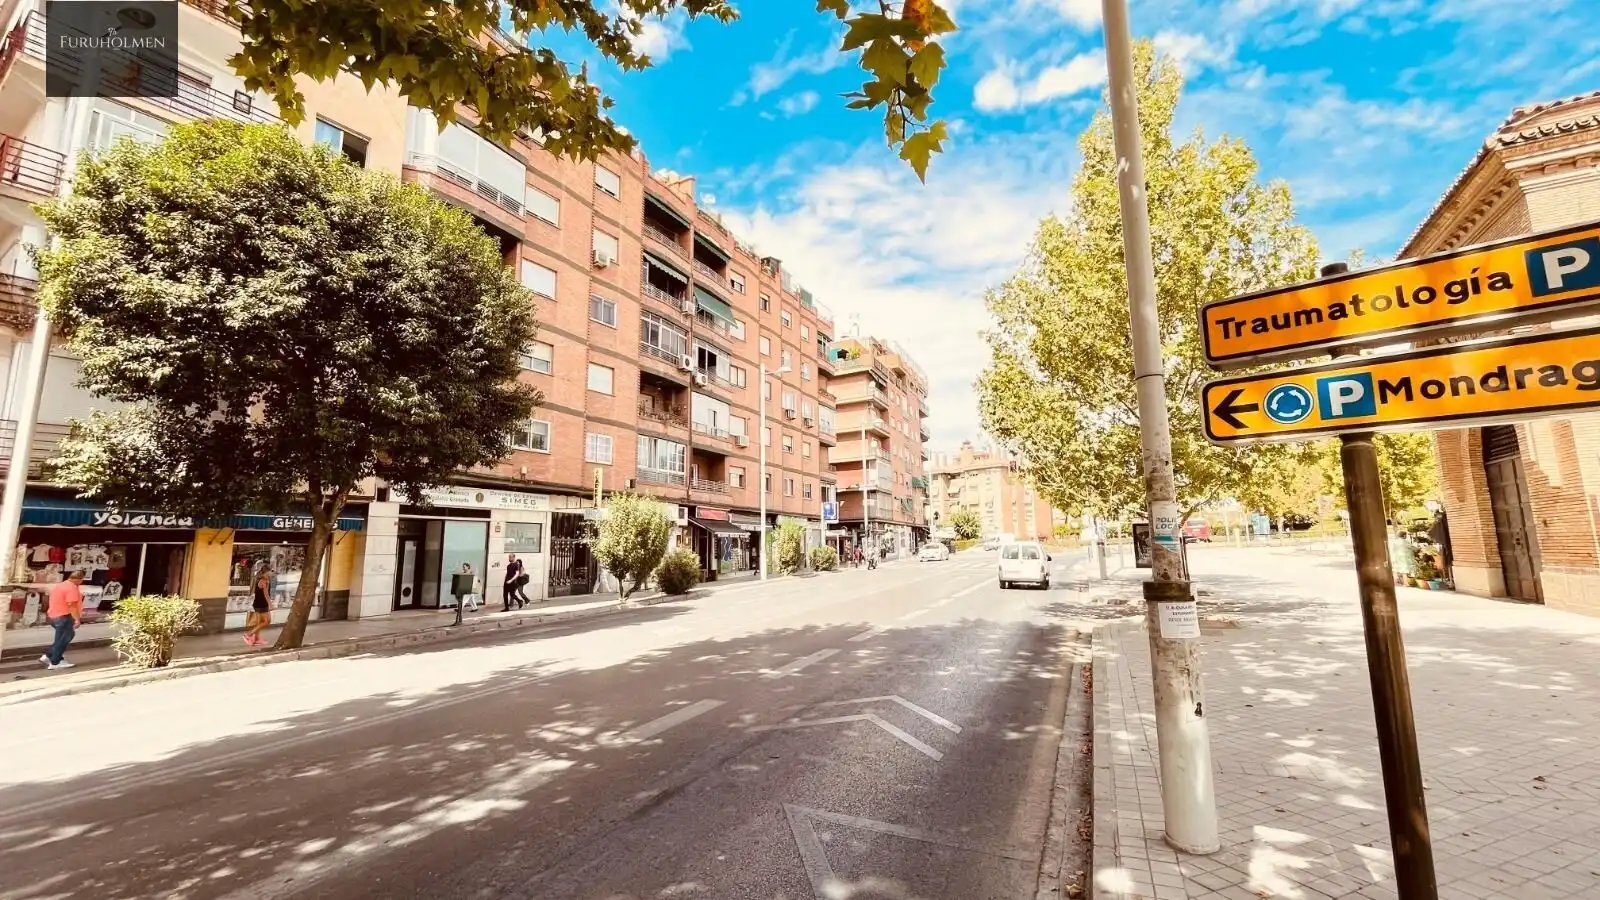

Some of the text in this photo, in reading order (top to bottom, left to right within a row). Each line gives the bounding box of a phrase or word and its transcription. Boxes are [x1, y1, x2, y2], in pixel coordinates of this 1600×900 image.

[1215, 246, 1591, 340] Traumatología P
[1329, 379, 1365, 416] P
